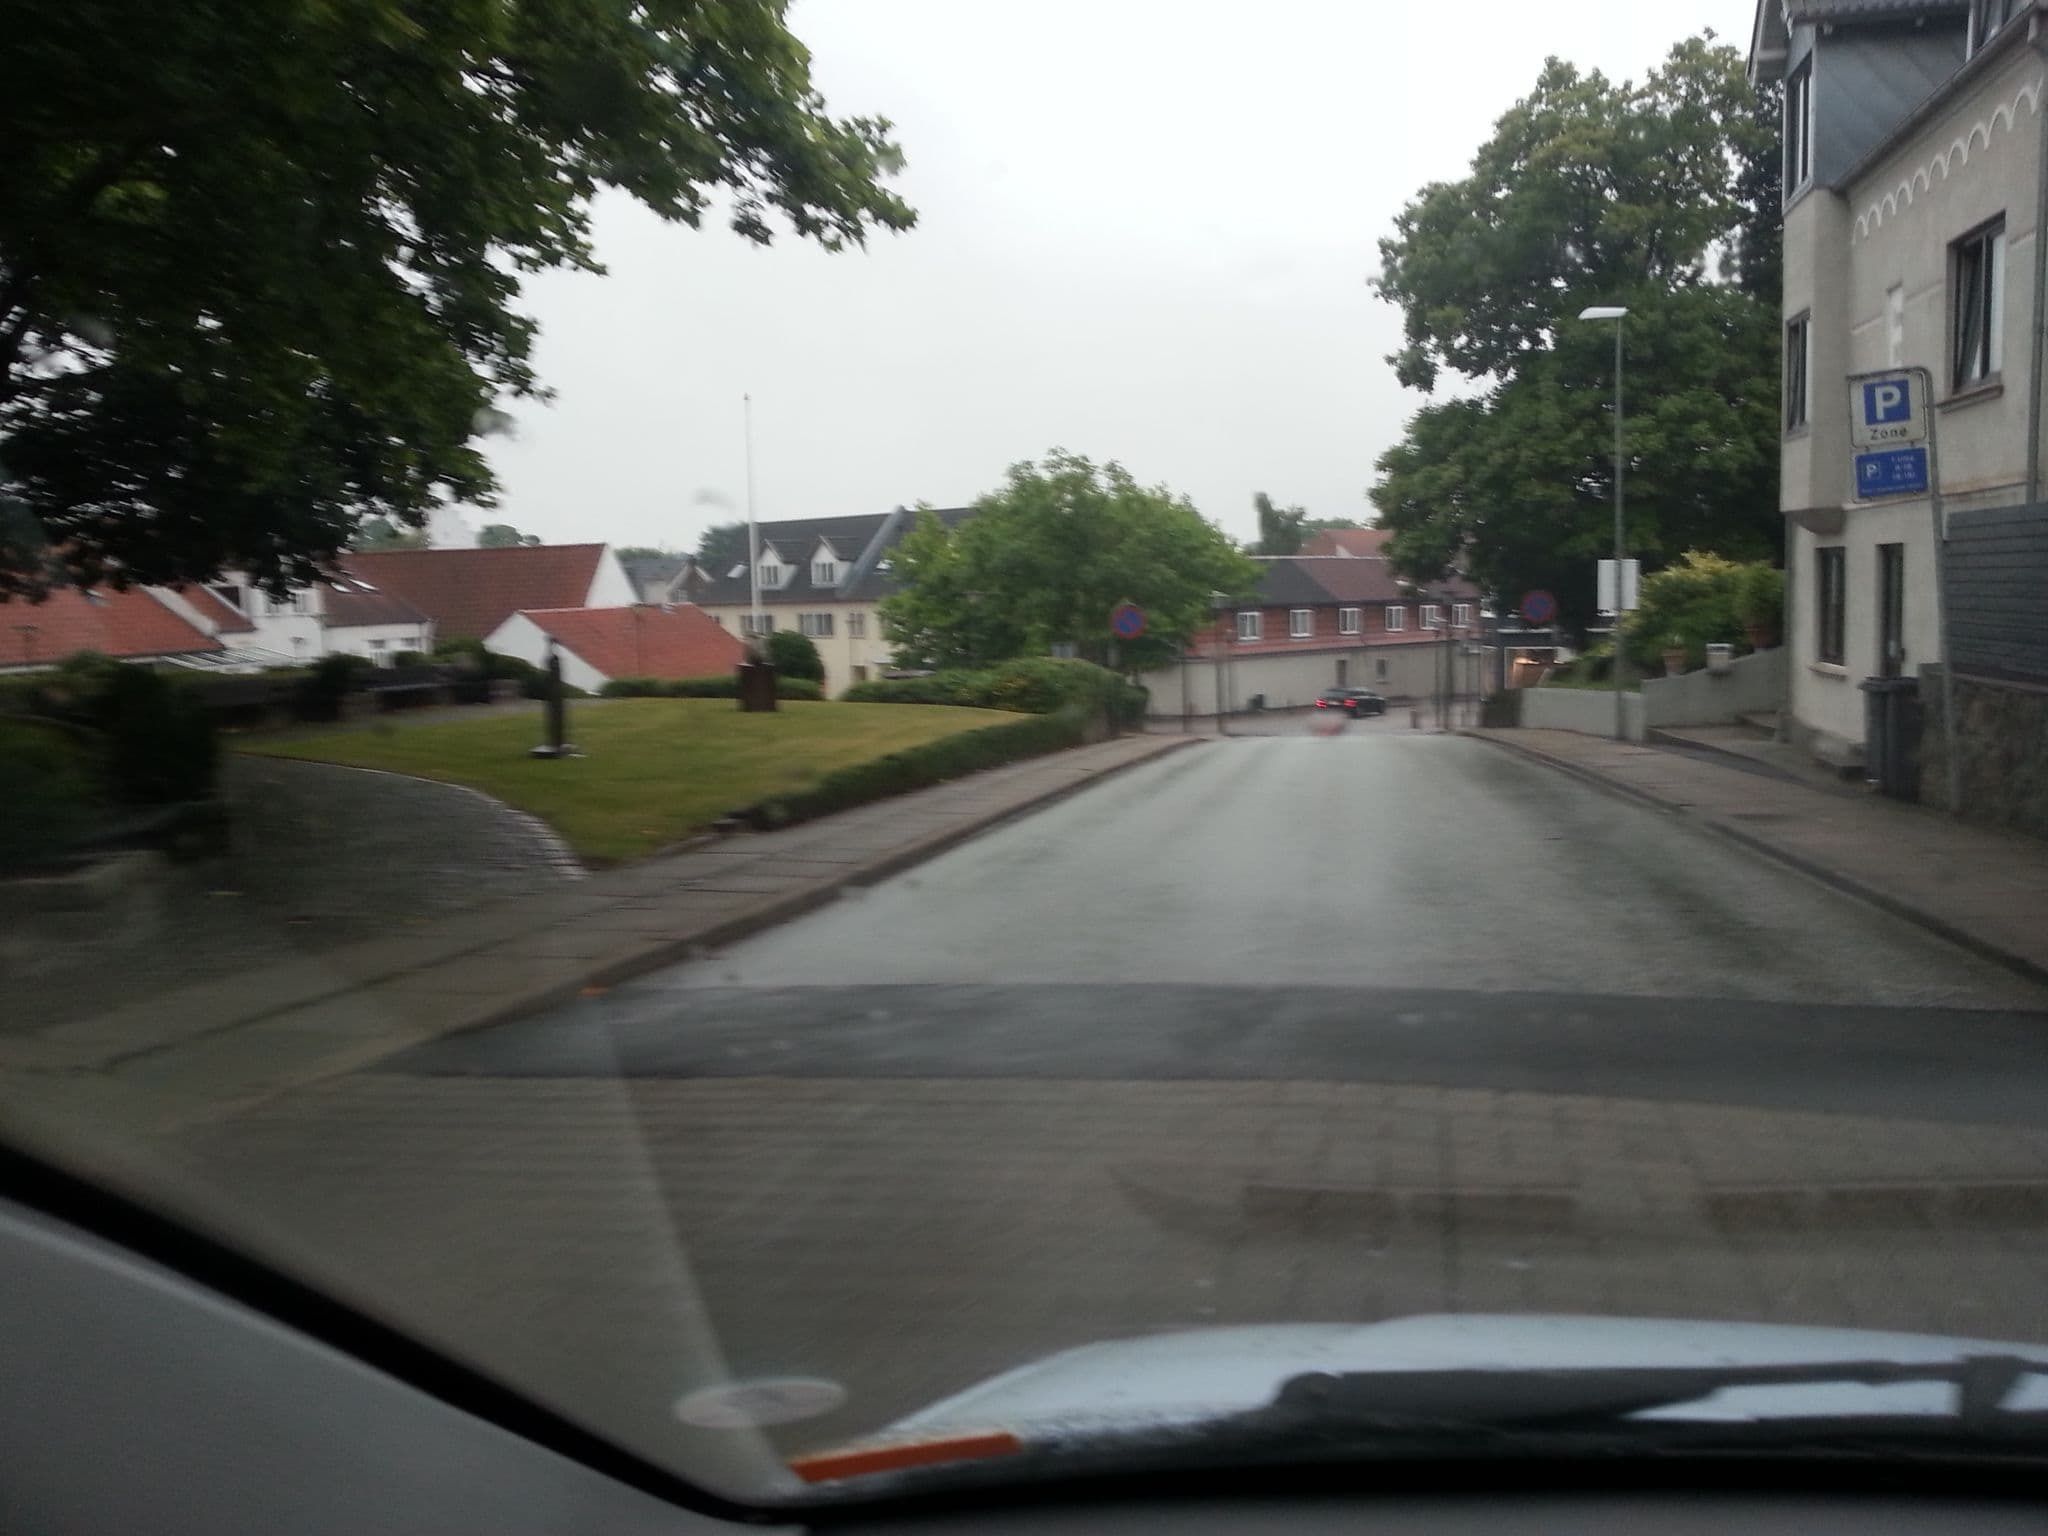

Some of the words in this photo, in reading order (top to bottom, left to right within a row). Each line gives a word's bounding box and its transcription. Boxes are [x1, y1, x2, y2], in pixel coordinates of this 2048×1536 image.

[1875, 385, 1901, 420] P
[1870, 428, 1907, 441] Zone
[1866, 463, 1877, 479] P
